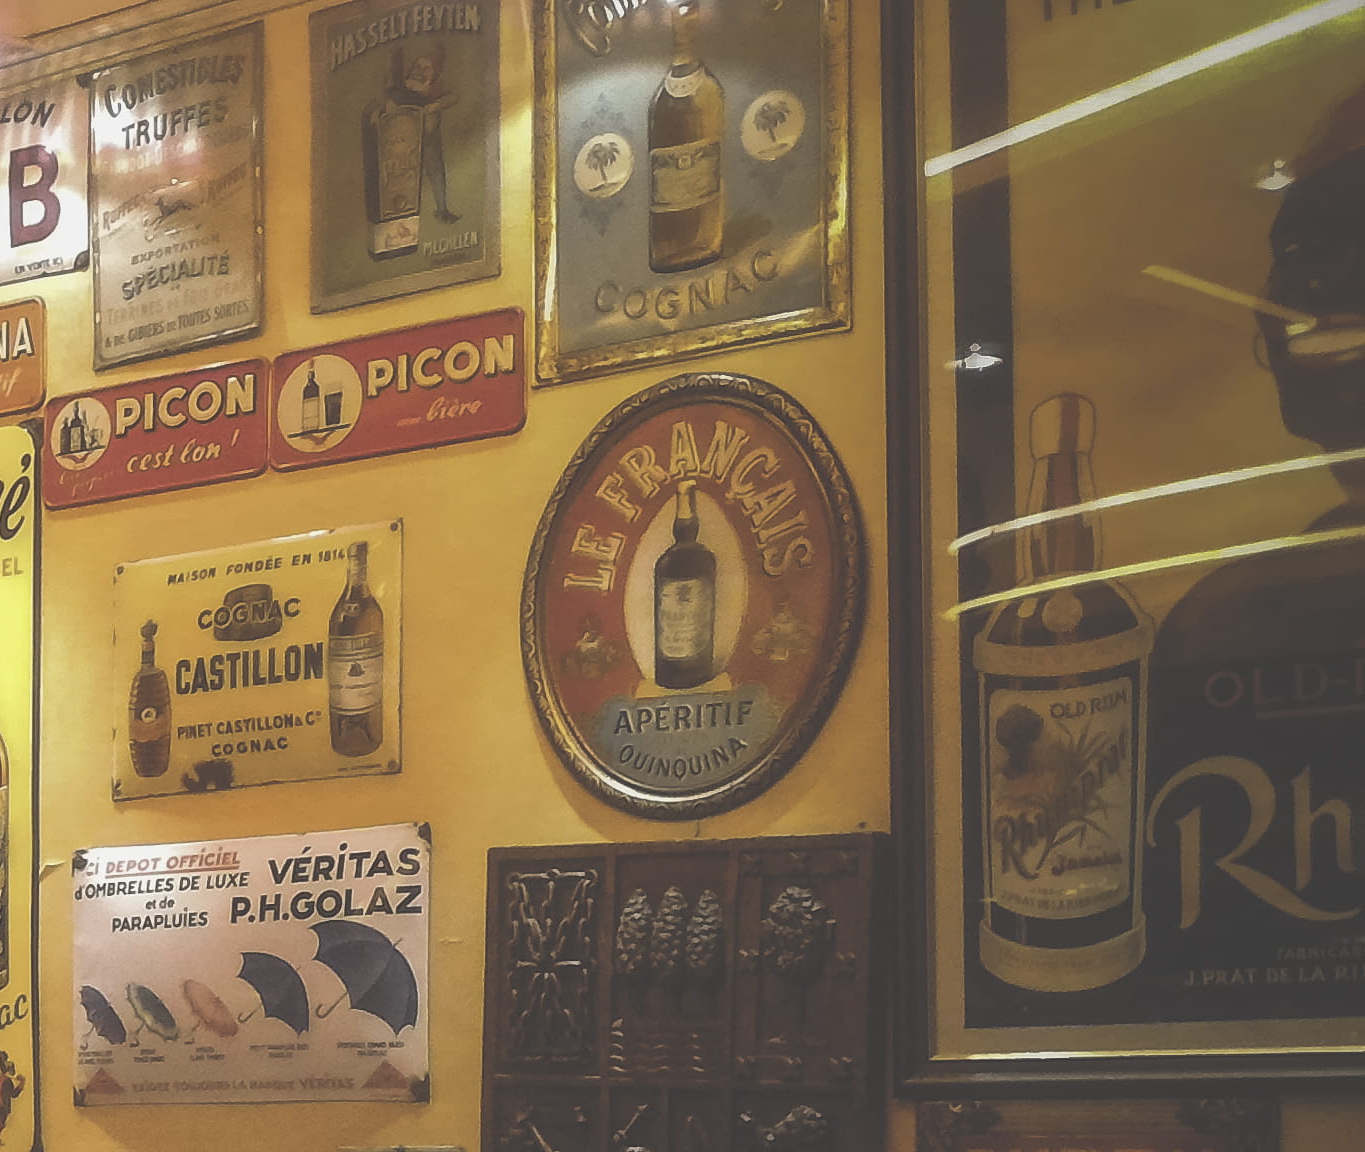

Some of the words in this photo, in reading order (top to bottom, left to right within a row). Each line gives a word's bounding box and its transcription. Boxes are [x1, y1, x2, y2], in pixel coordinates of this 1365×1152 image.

[104, 54, 246, 117] COMESTIBLES
[123, 99, 229, 150] TRUFFES
[594, 250, 779, 320] COGNAC
[368, 334, 515, 400] PICON
[115, 374, 255, 438] PICON
[563, 524, 625, 593] LE
[595, 420, 814, 578] FRANÇAIS
[167, 567, 217, 587] MAISON
[225, 554, 283, 576] FONDÉE
[290, 552, 311, 567] EN
[197, 597, 302, 631] COGNAC
[175, 642, 325, 696] CASTILLON
[216, 714, 294, 736] CASTILLON
[613, 698, 756, 738] APÉRITIF
[211, 737, 288, 757] COGNAC
[618, 735, 749, 782] QUINQUINA
[74, 876, 175, 902] d'OMBRELLES
[178, 876, 201, 893] DE
[206, 871, 250, 892] LUXE
[105, 857, 163, 875] DEPOT
